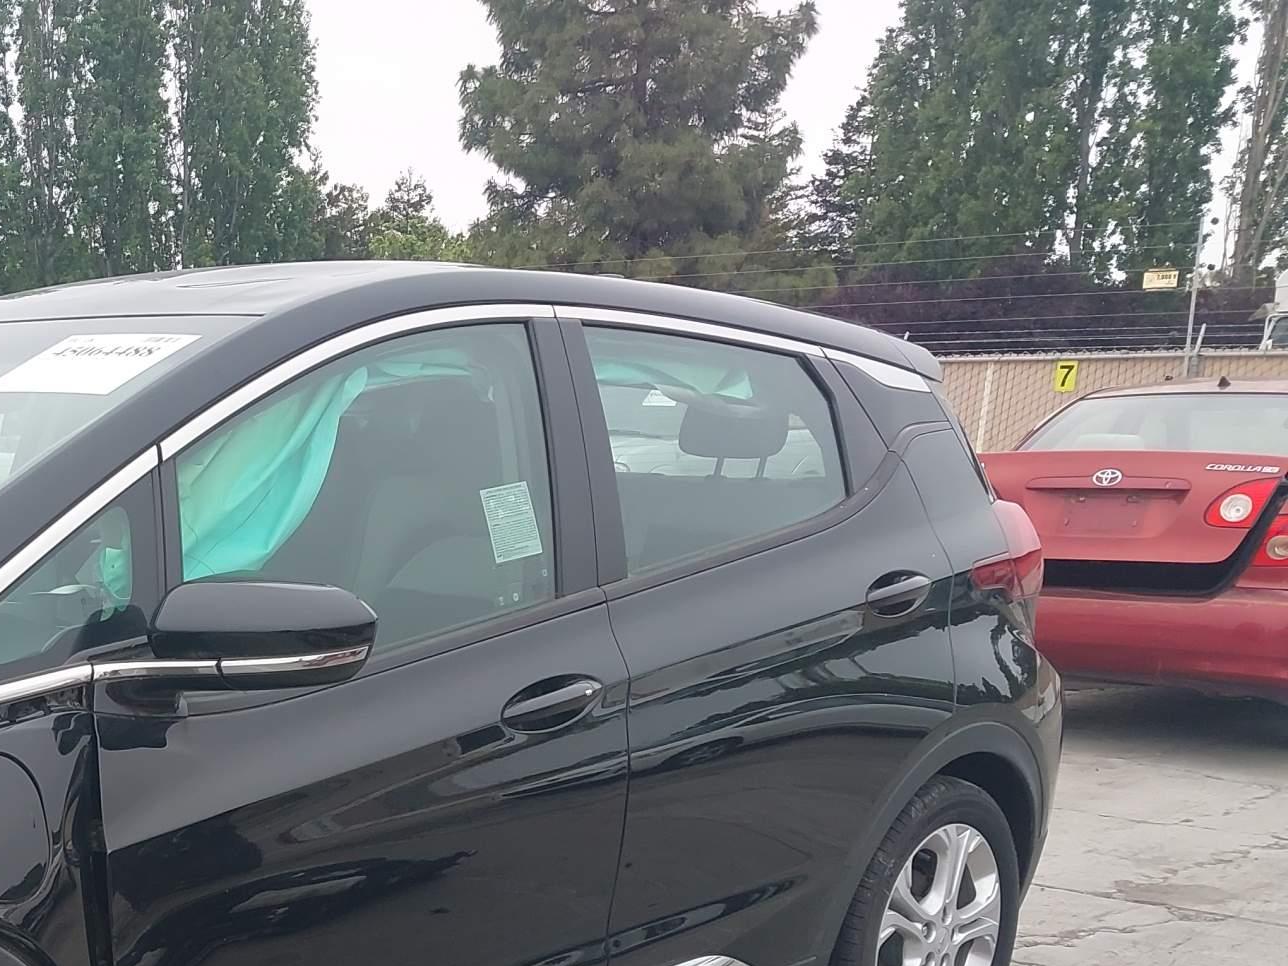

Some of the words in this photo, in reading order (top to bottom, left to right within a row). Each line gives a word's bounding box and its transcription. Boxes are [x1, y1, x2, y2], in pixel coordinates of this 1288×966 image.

[52, 345, 161, 358] 45064488
[1058, 364, 1076, 387] 7
[1205, 463, 1262, 473] COROLLA
